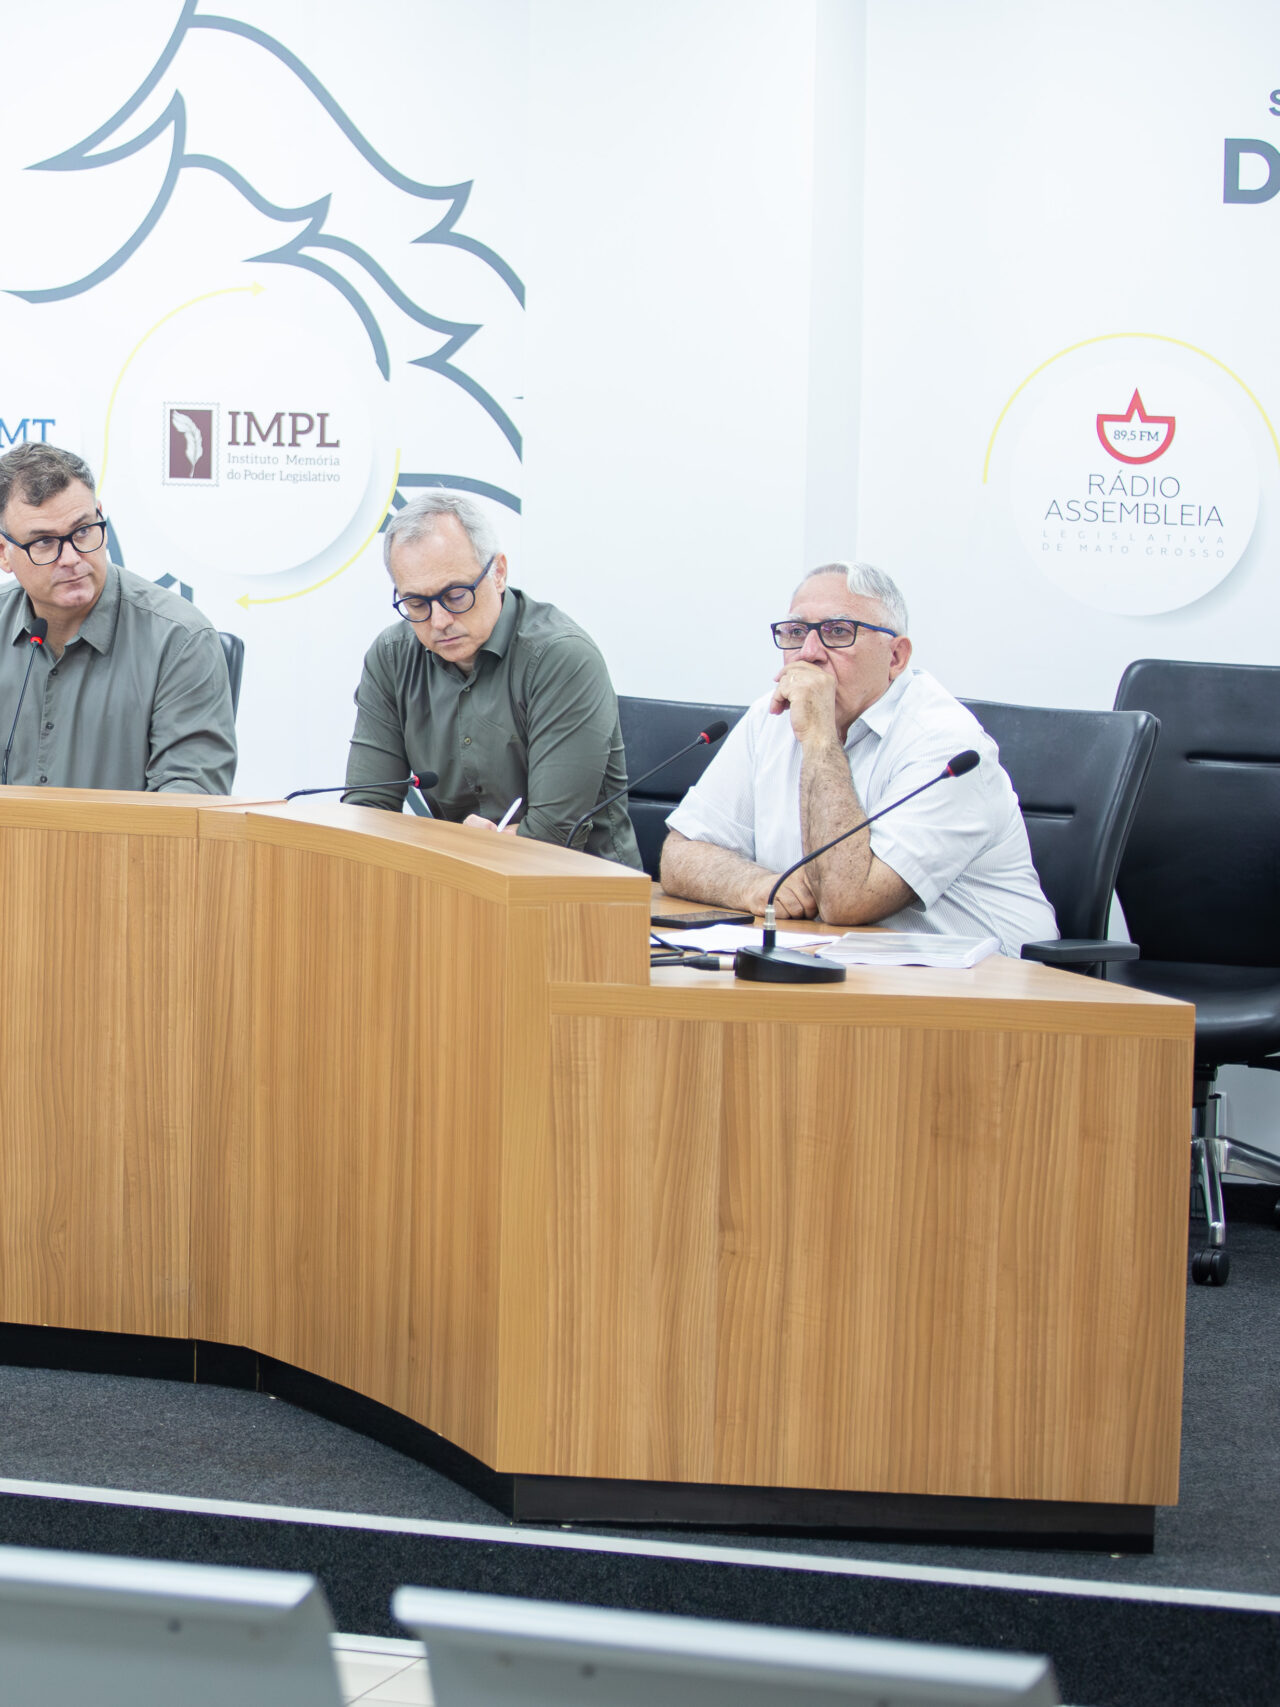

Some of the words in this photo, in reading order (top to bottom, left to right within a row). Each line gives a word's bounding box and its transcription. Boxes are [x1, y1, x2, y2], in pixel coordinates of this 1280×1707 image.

[228, 411, 340, 448] IMPL
[1113, 429, 1136, 442] 89,5
[1139, 430, 1159, 442] FM
[227, 452, 280, 465] Instituto
[285, 453, 341, 466] Memória
[226, 468, 241, 481] do
[243, 468, 277, 482] Poder
[279, 470, 341, 484] Legislativo
[1088, 470, 1181, 499] RÁDIO
[1044, 499, 1225, 528] ASSEMBLEIA
[1042, 530, 1224, 545] LEGISLATIVA
[1042, 542, 1063, 552] DE
[1079, 543, 1130, 555] MATO
[1145, 546, 1225, 559] GROSSO
